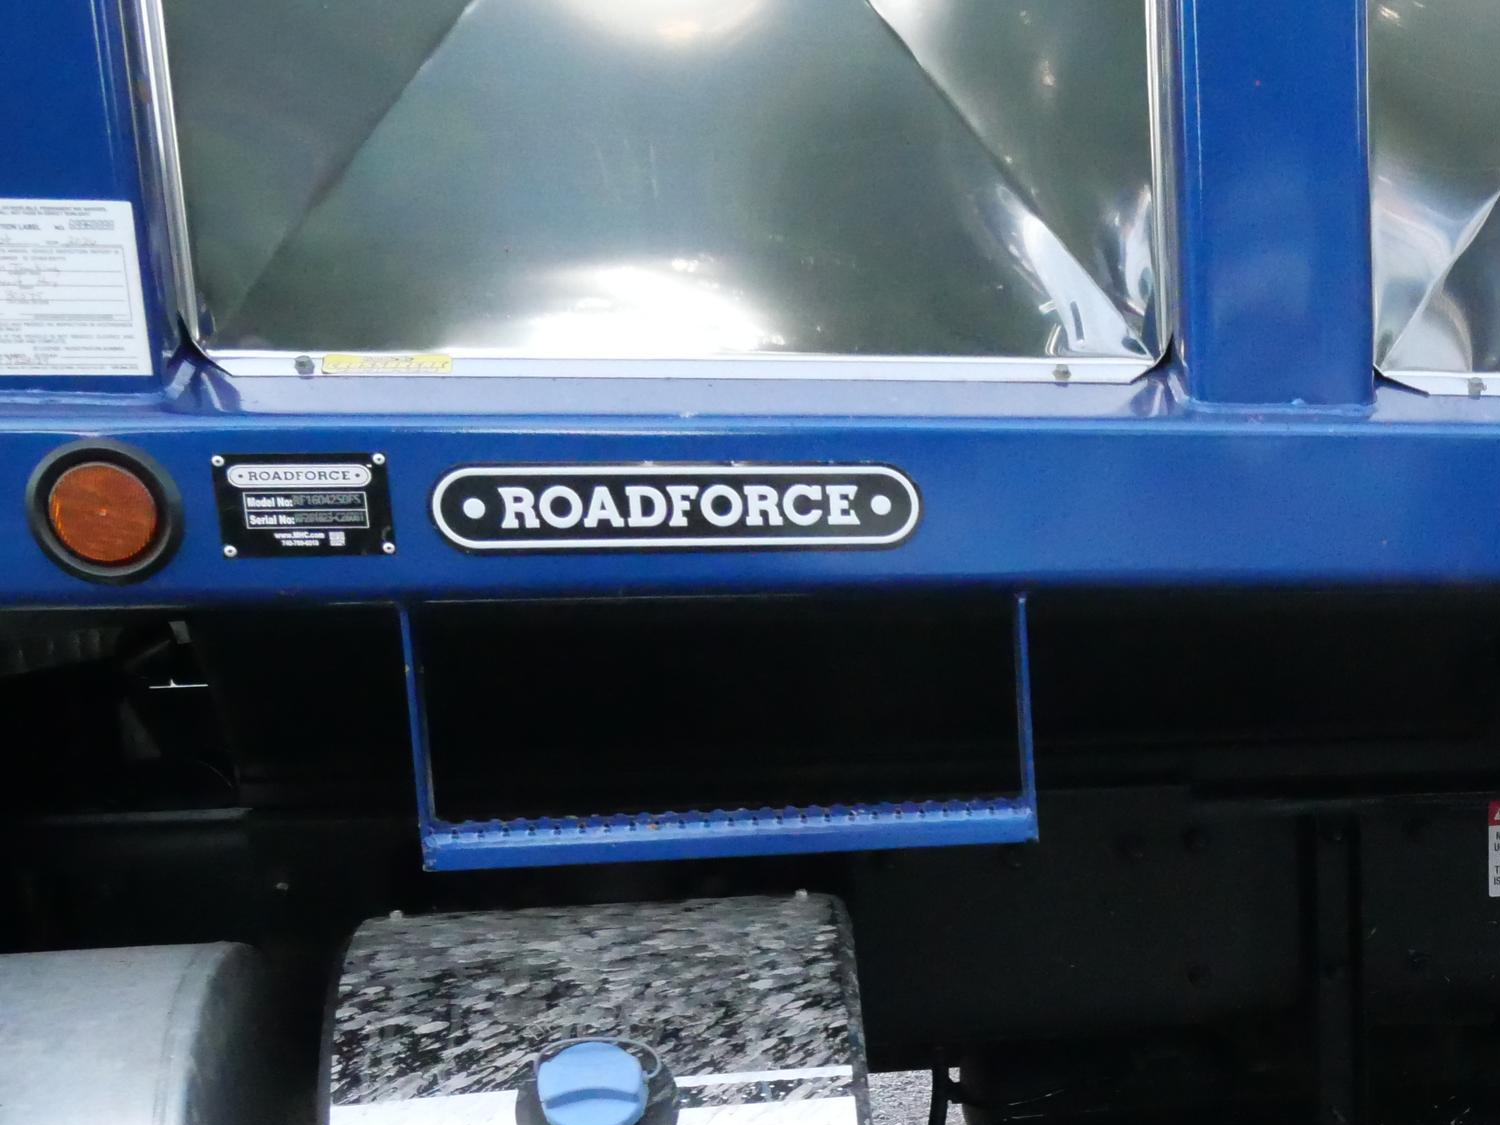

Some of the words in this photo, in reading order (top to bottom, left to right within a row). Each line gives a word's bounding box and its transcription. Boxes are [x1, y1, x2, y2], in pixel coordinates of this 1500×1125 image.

[248, 471, 351, 481] ROADFORCE
[247, 497, 275, 507] Model
[277, 497, 293, 507] No:
[497, 484, 861, 529] ROADFORCE
[250, 514, 277, 525] Serial
[279, 515, 295, 525] No:
[1493, 876, 1500, 886] IS
